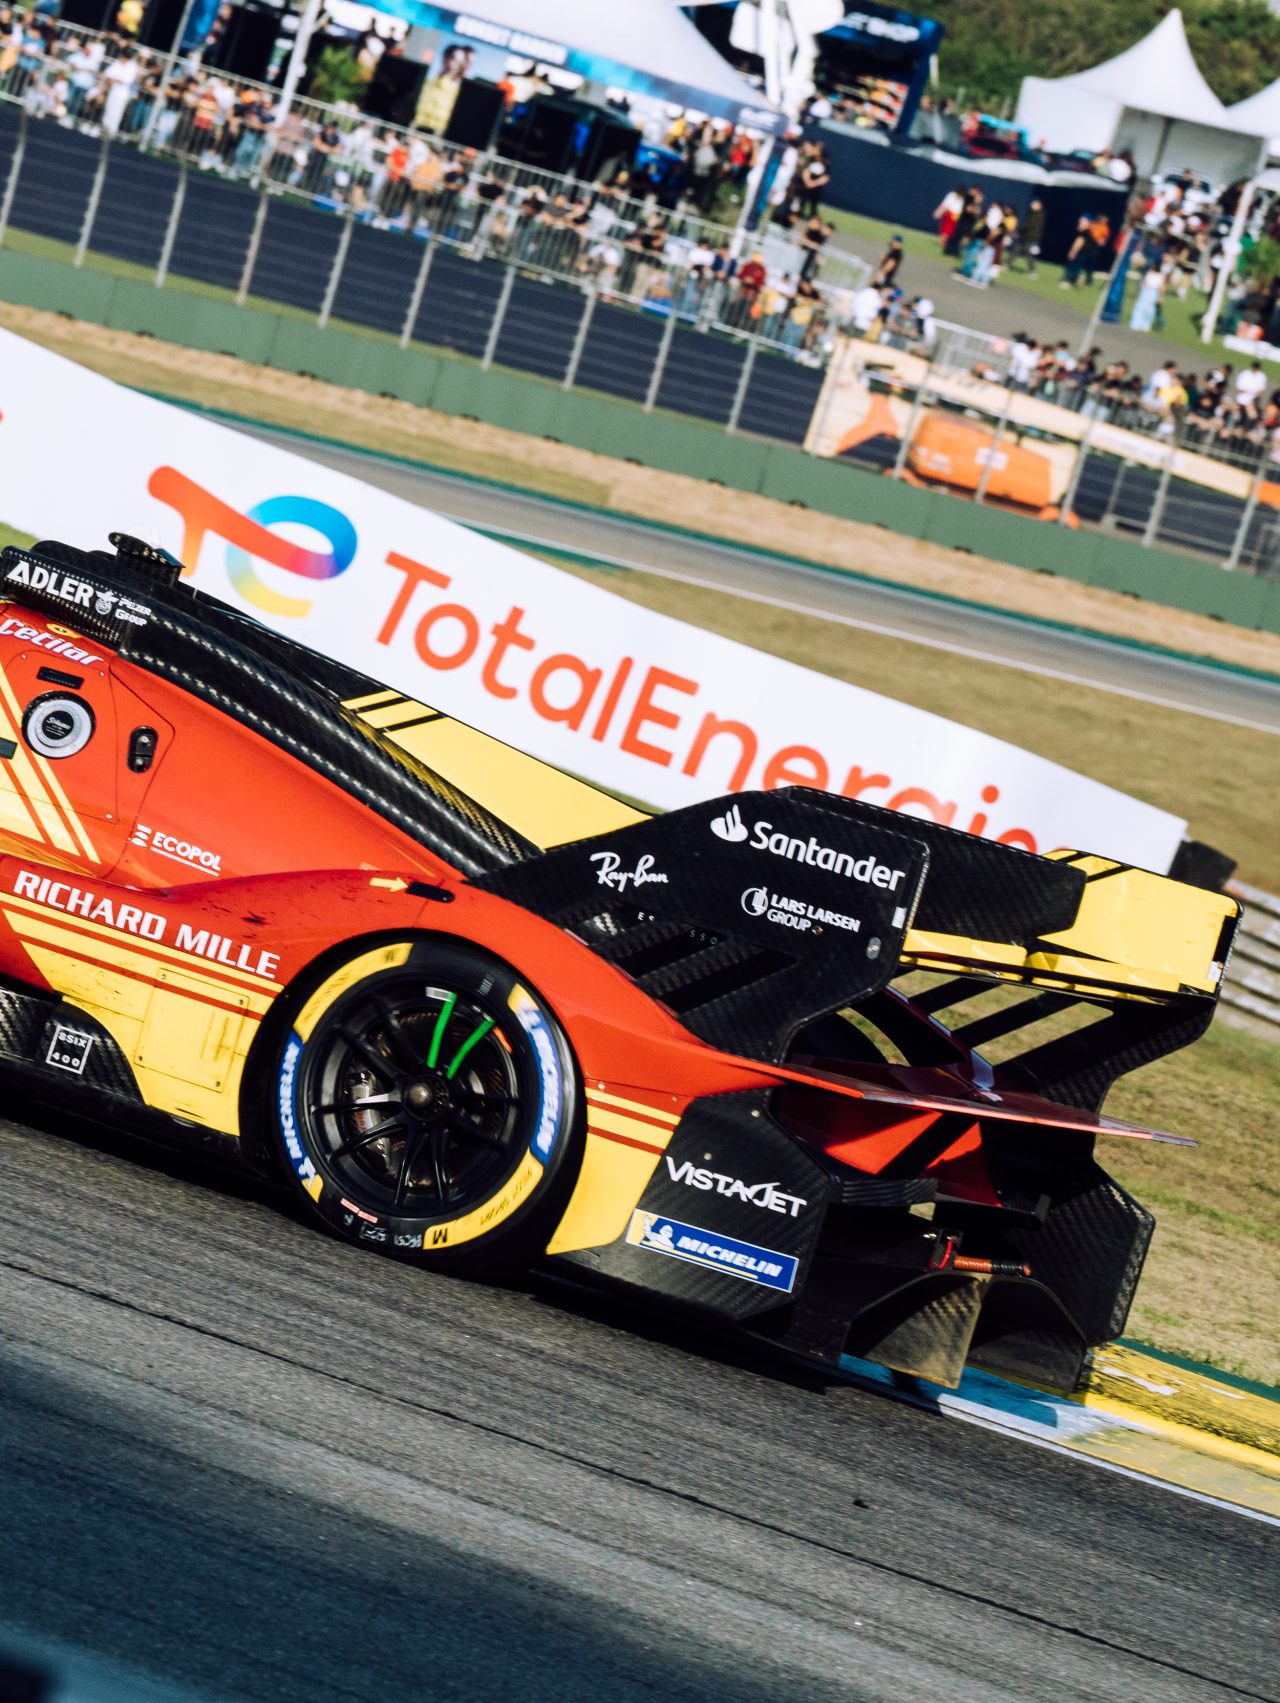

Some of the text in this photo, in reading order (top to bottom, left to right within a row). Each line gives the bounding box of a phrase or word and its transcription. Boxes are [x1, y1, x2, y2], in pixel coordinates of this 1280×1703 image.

[6, 560, 95, 609] ADLER
[152, 831, 221, 872] ECOPOL
[749, 820, 906, 892] Santander
[12, 870, 281, 979] RICHARD MILLE
[767, 908, 812, 933] GROUP
[771, 894, 861, 933] LARS LARSEN
[279, 1040, 303, 1160] MICHELIN
[665, 1155, 808, 1218] VISTAJET
[675, 1235, 784, 1278] MICHELIN
